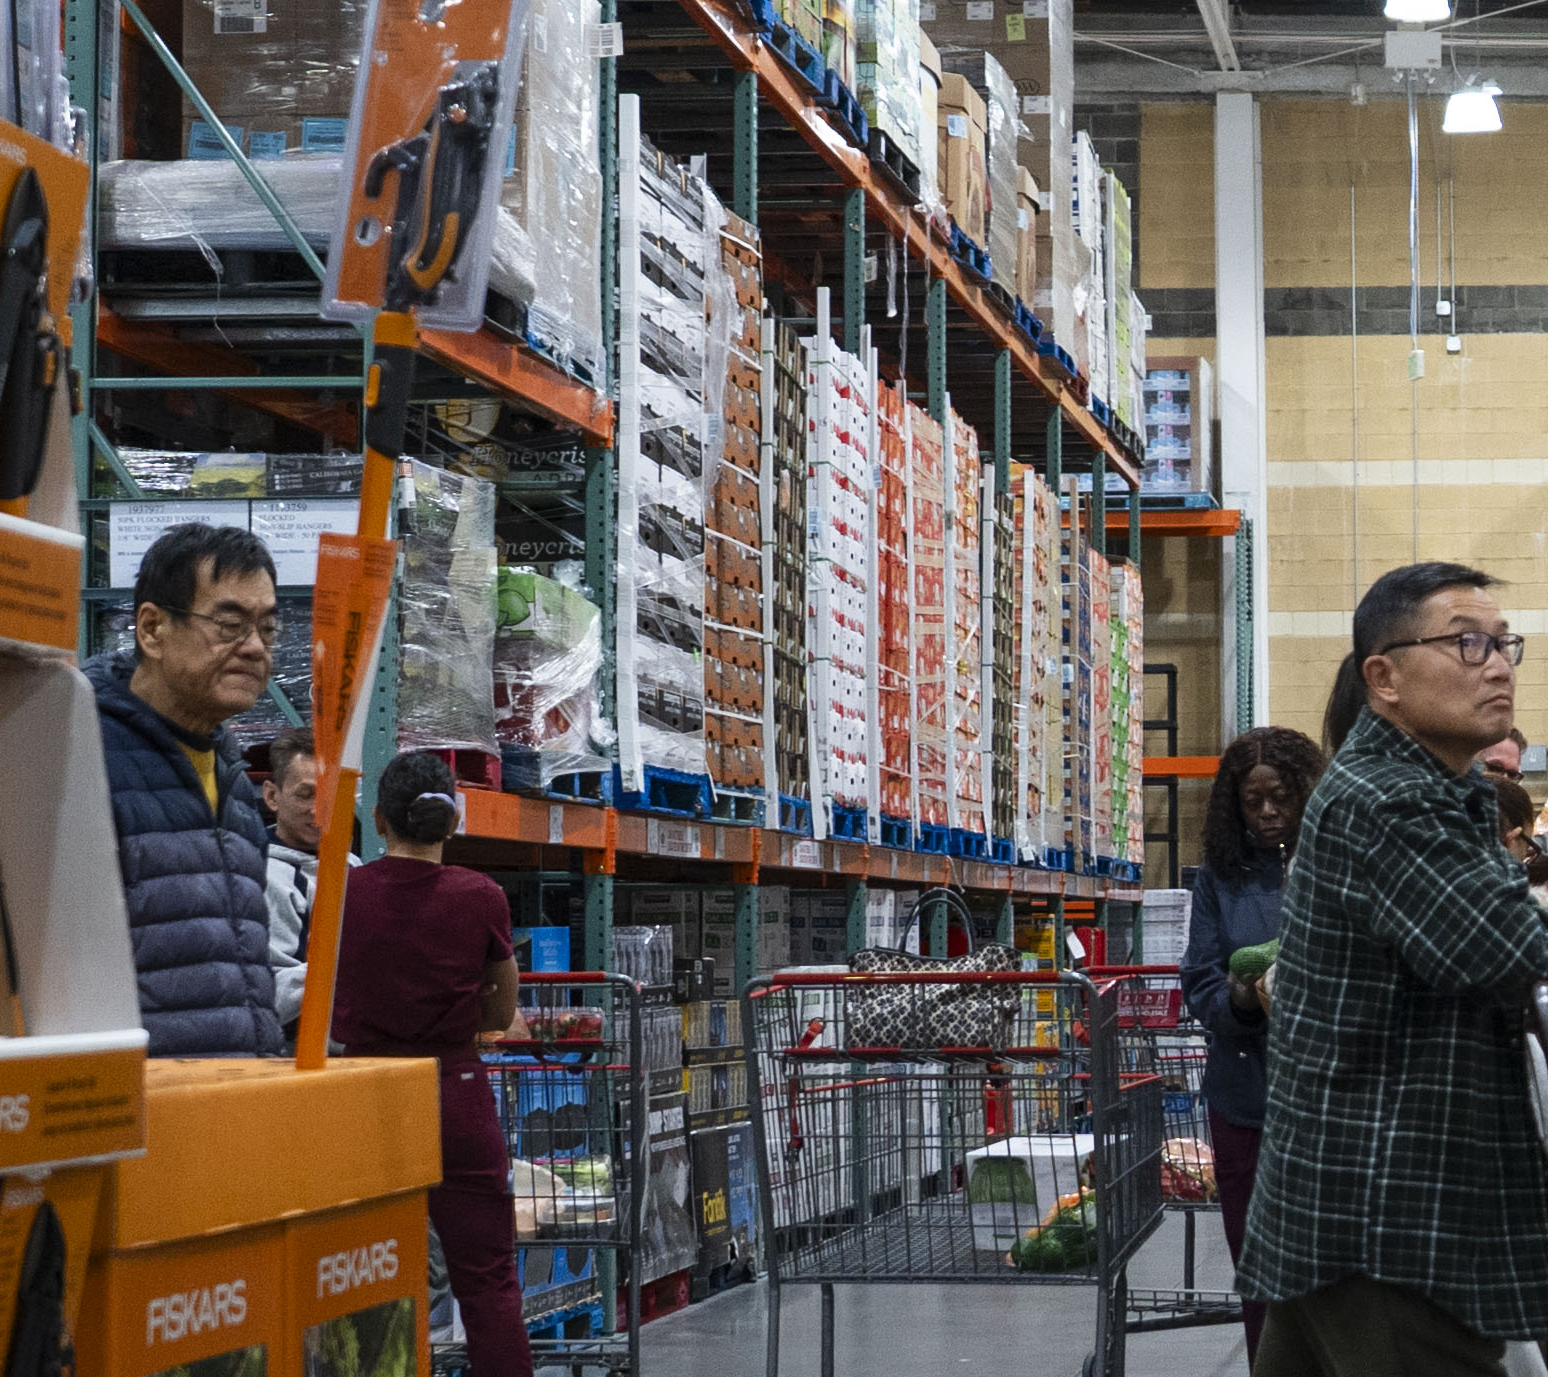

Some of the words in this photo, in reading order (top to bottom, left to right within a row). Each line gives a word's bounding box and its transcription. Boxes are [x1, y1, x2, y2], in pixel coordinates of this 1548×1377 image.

[471, 445, 586, 471] Honeycris
[137, 515, 172, 523] FLOCKED
[321, 544, 360, 560] FISKARS
[318, 1239, 399, 1298] FISKARS
[146, 1280, 248, 1346] FISKARS
